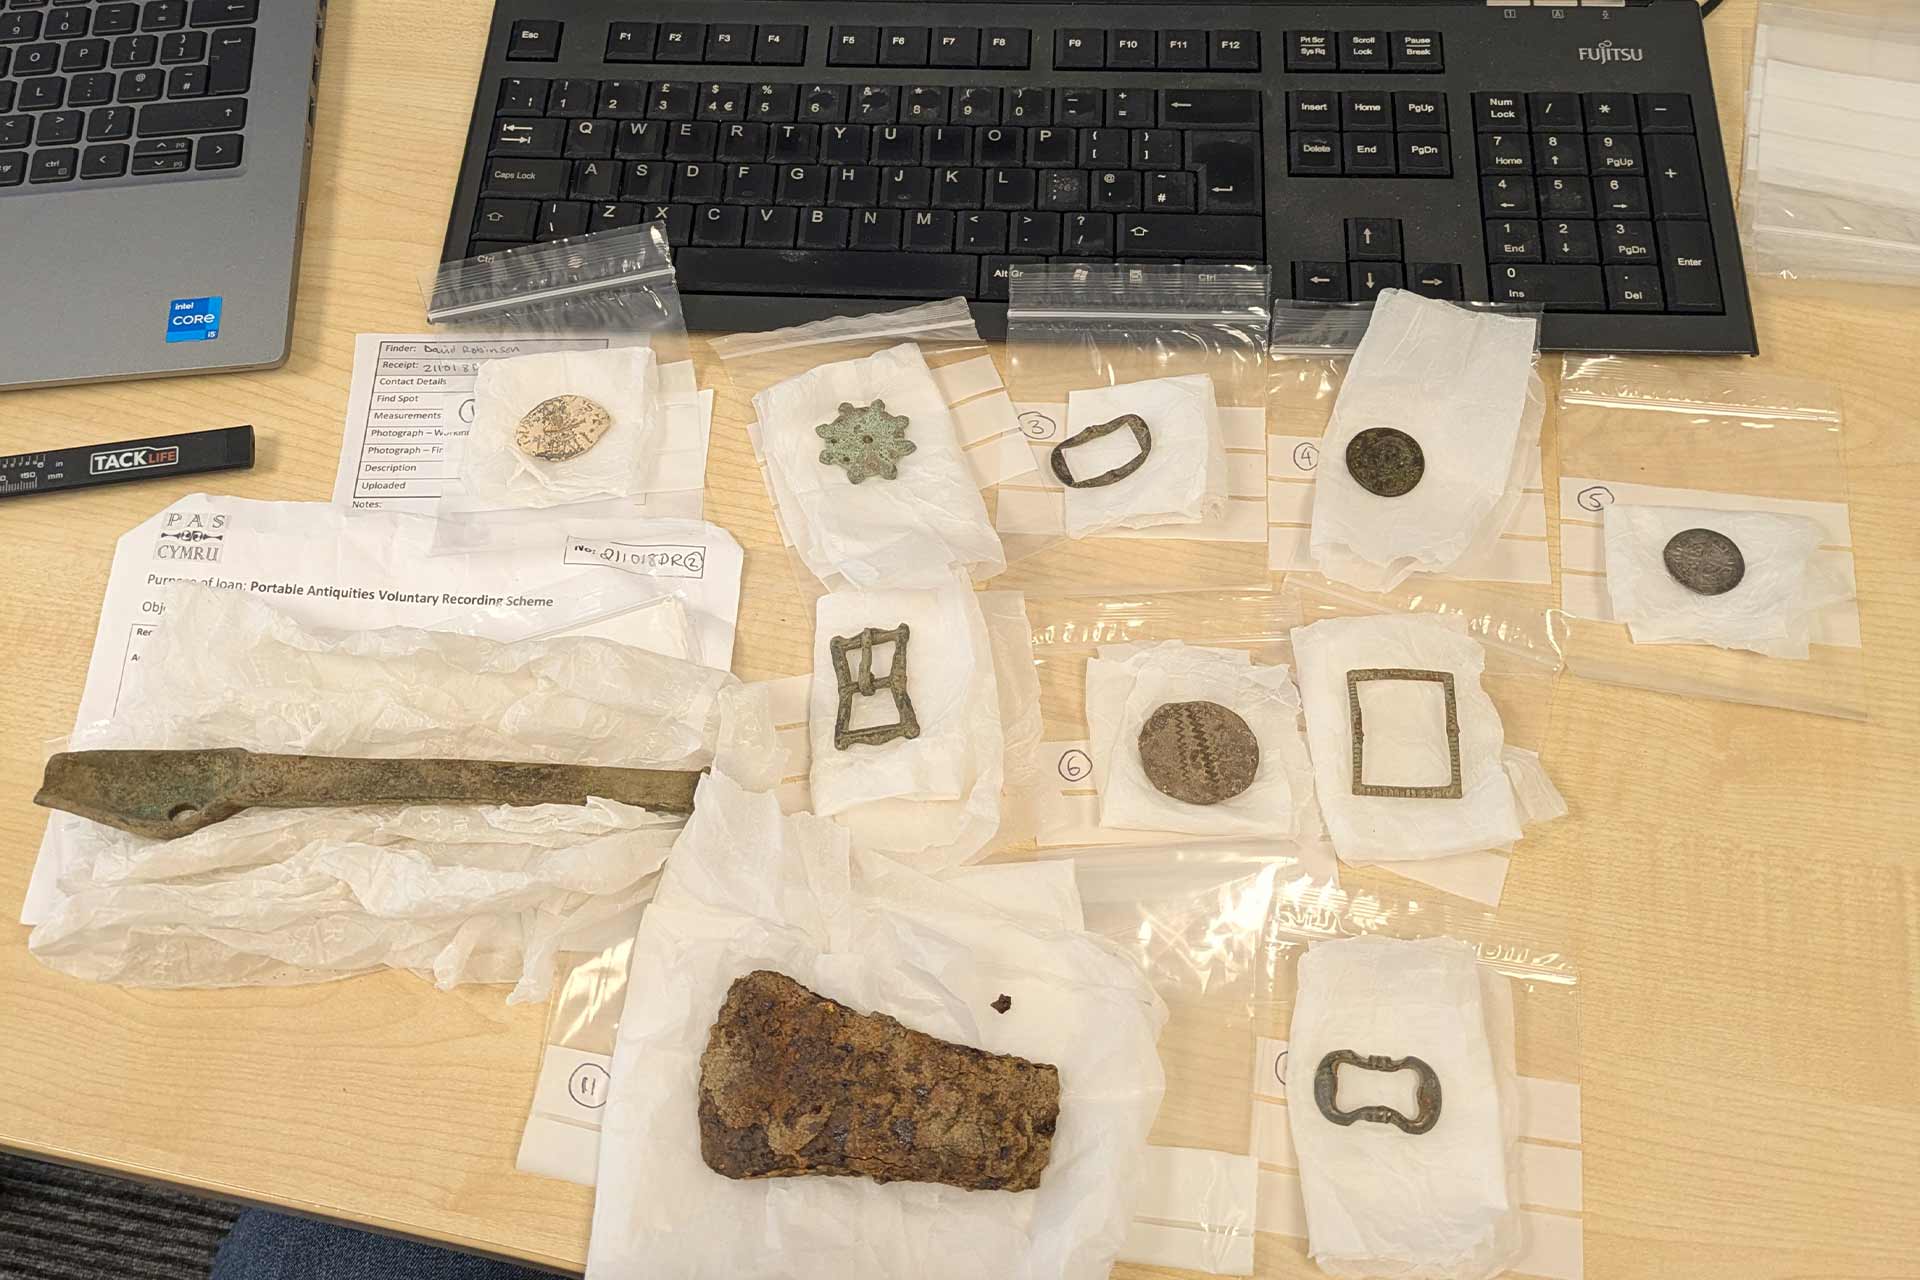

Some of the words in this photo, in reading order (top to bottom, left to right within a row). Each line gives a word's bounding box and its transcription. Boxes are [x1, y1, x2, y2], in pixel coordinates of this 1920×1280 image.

[522, 31, 538, 39] Esc
[669, 33, 681, 41] F2
[718, 33, 731, 42] F3
[768, 35, 780, 43] F4
[843, 36, 854, 44] F5
[892, 37, 904, 45] F6
[993, 38, 1005, 46] F8
[1069, 39, 1081, 47] F9
[1120, 41, 1137, 49] F10
[1170, 41, 1187, 49] F11
[1222, 41, 1240, 49] F12
[80, 48, 88, 57] P
[1579, 40, 1643, 64] FUJITSU
[36, 87, 44, 96] L
[560, 99, 566, 108] 1
[609, 100, 617, 108] 2
[659, 101, 667, 109] 3
[709, 102, 716, 110] 4
[761, 103, 769, 111] 5
[811, 104, 819, 112] 6
[1409, 104, 1434, 112] PgUp
[862, 104, 870, 113] 7
[913, 105, 920, 114] 8
[964, 106, 972, 115] 9
[1016, 107, 1023, 116] 0
[1491, 110, 1515, 118] Lock
[579, 122, 592, 133] Q
[631, 123, 647, 134] W
[681, 124, 691, 135] E
[731, 125, 743, 136] R
[783, 126, 794, 137] T
[835, 127, 846, 138] Y
[885, 128, 896, 139] U
[988, 130, 1001, 141] O
[1041, 130, 1051, 141] P
[1494, 137, 1501, 145] 7
[1549, 137, 1557, 146] 8
[1604, 138, 1612, 146] 9
[1412, 146, 1437, 155] PgDn
[1607, 158, 1633, 167] PgUp
[585, 164, 597, 174] A
[636, 165, 647, 176] S
[687, 166, 699, 176] D
[739, 167, 749, 178] F
[791, 168, 803, 179] G
[495, 171, 514, 179] Caps
[517, 171, 535, 179] Lock
[843, 169, 854, 180] H
[895, 170, 903, 181] J
[946, 171, 958, 182] K
[999, 172, 1008, 183] L
[1104, 174, 1115, 183] @
[1499, 180, 1506, 188] 4
[1554, 180, 1562, 189] 5
[1610, 180, 1619, 189] 6
[1158, 194, 1166, 202] #
[603, 206, 615, 217] Z
[656, 207, 668, 218] X
[708, 208, 720, 220] C
[761, 209, 773, 220] V
[812, 211, 823, 222] B
[864, 212, 876, 224] N
[917, 213, 931, 225] M
[1077, 216, 1085, 225] ?
[1504, 224, 1510, 232] 1
[1559, 224, 1568, 233] 2
[1616, 224, 1624, 234] 3
[1619, 246, 1646, 255] PgDn
[477, 255, 495, 264] Ctrl
[1678, 258, 1702, 266] Enter
[993, 269, 1008, 278] Alt
[1011, 270, 1024, 279] Gr
[1507, 268, 1516, 278] 0
[1199, 274, 1217, 282] Ctrl
[1509, 290, 1524, 298] Ins
[1625, 291, 1642, 299] Del
[175, 301, 194, 310] intel
[383, 361, 419, 370] Receipt:
[398, 395, 419, 403] Spot
[371, 429, 424, 438] Photograph
[368, 446, 422, 455] Photograph
[365, 463, 417, 473] Description
[48, 472, 63, 480] mm
[361, 481, 406, 490] Uploaded
[352, 500, 382, 509] Notes:
[157, 545, 219, 561] CYMRU
[574, 545, 596, 555] No:
[216, 578, 247, 592] loan:
[250, 581, 304, 596] Portable
[307, 585, 375, 600] Antiquities
[378, 589, 439, 605] Voluntary
[442, 593, 503, 607] Recording
[506, 595, 553, 607] Scheme
